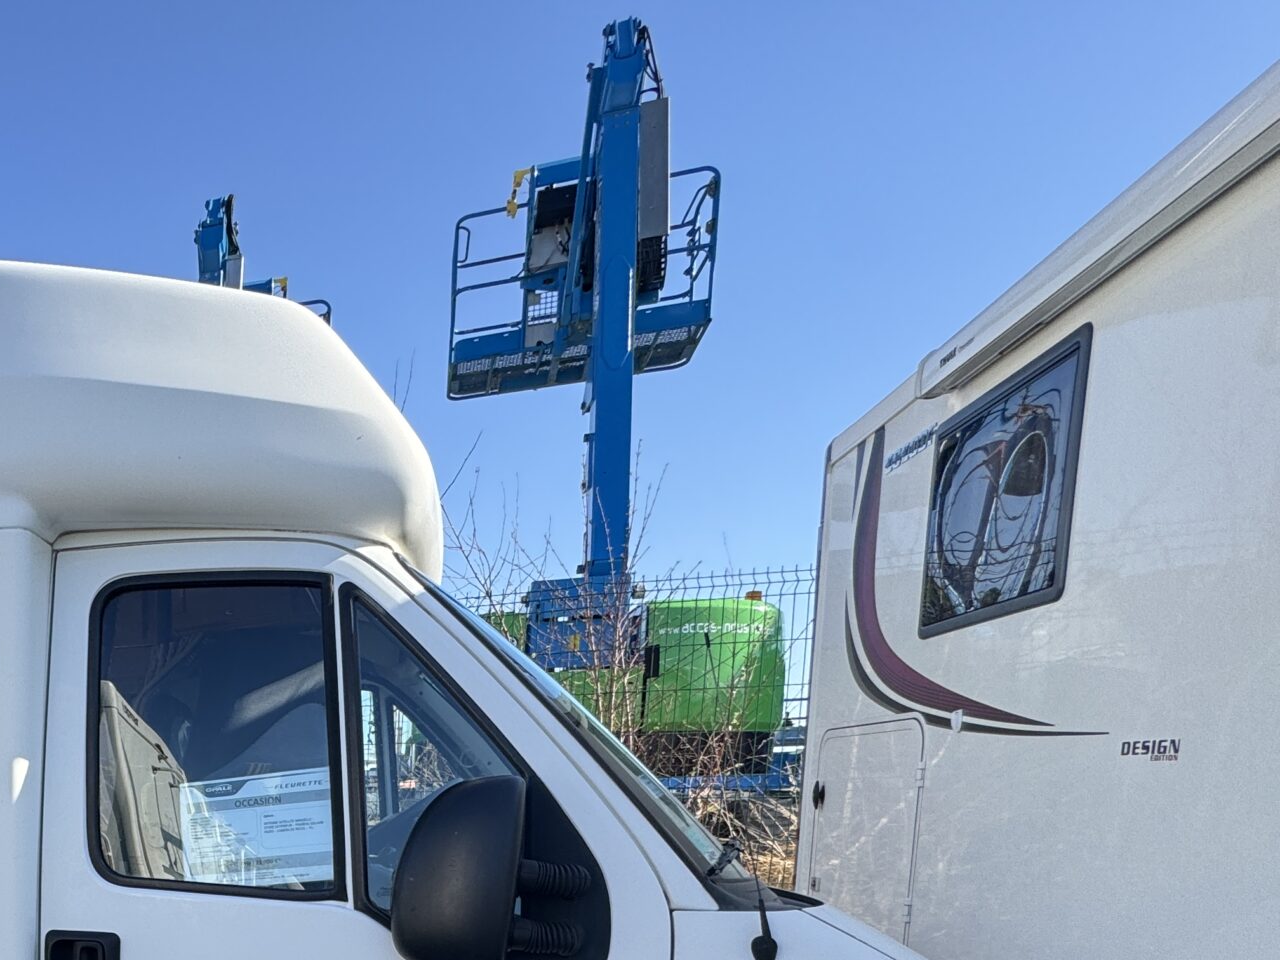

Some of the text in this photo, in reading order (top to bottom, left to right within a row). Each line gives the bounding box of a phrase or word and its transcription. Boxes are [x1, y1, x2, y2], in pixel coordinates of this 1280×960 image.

[1120, 739, 1181, 756] DESIGN
[274, 780, 323, 790] FLEURETTE
[234, 795, 282, 808] OCCASION
